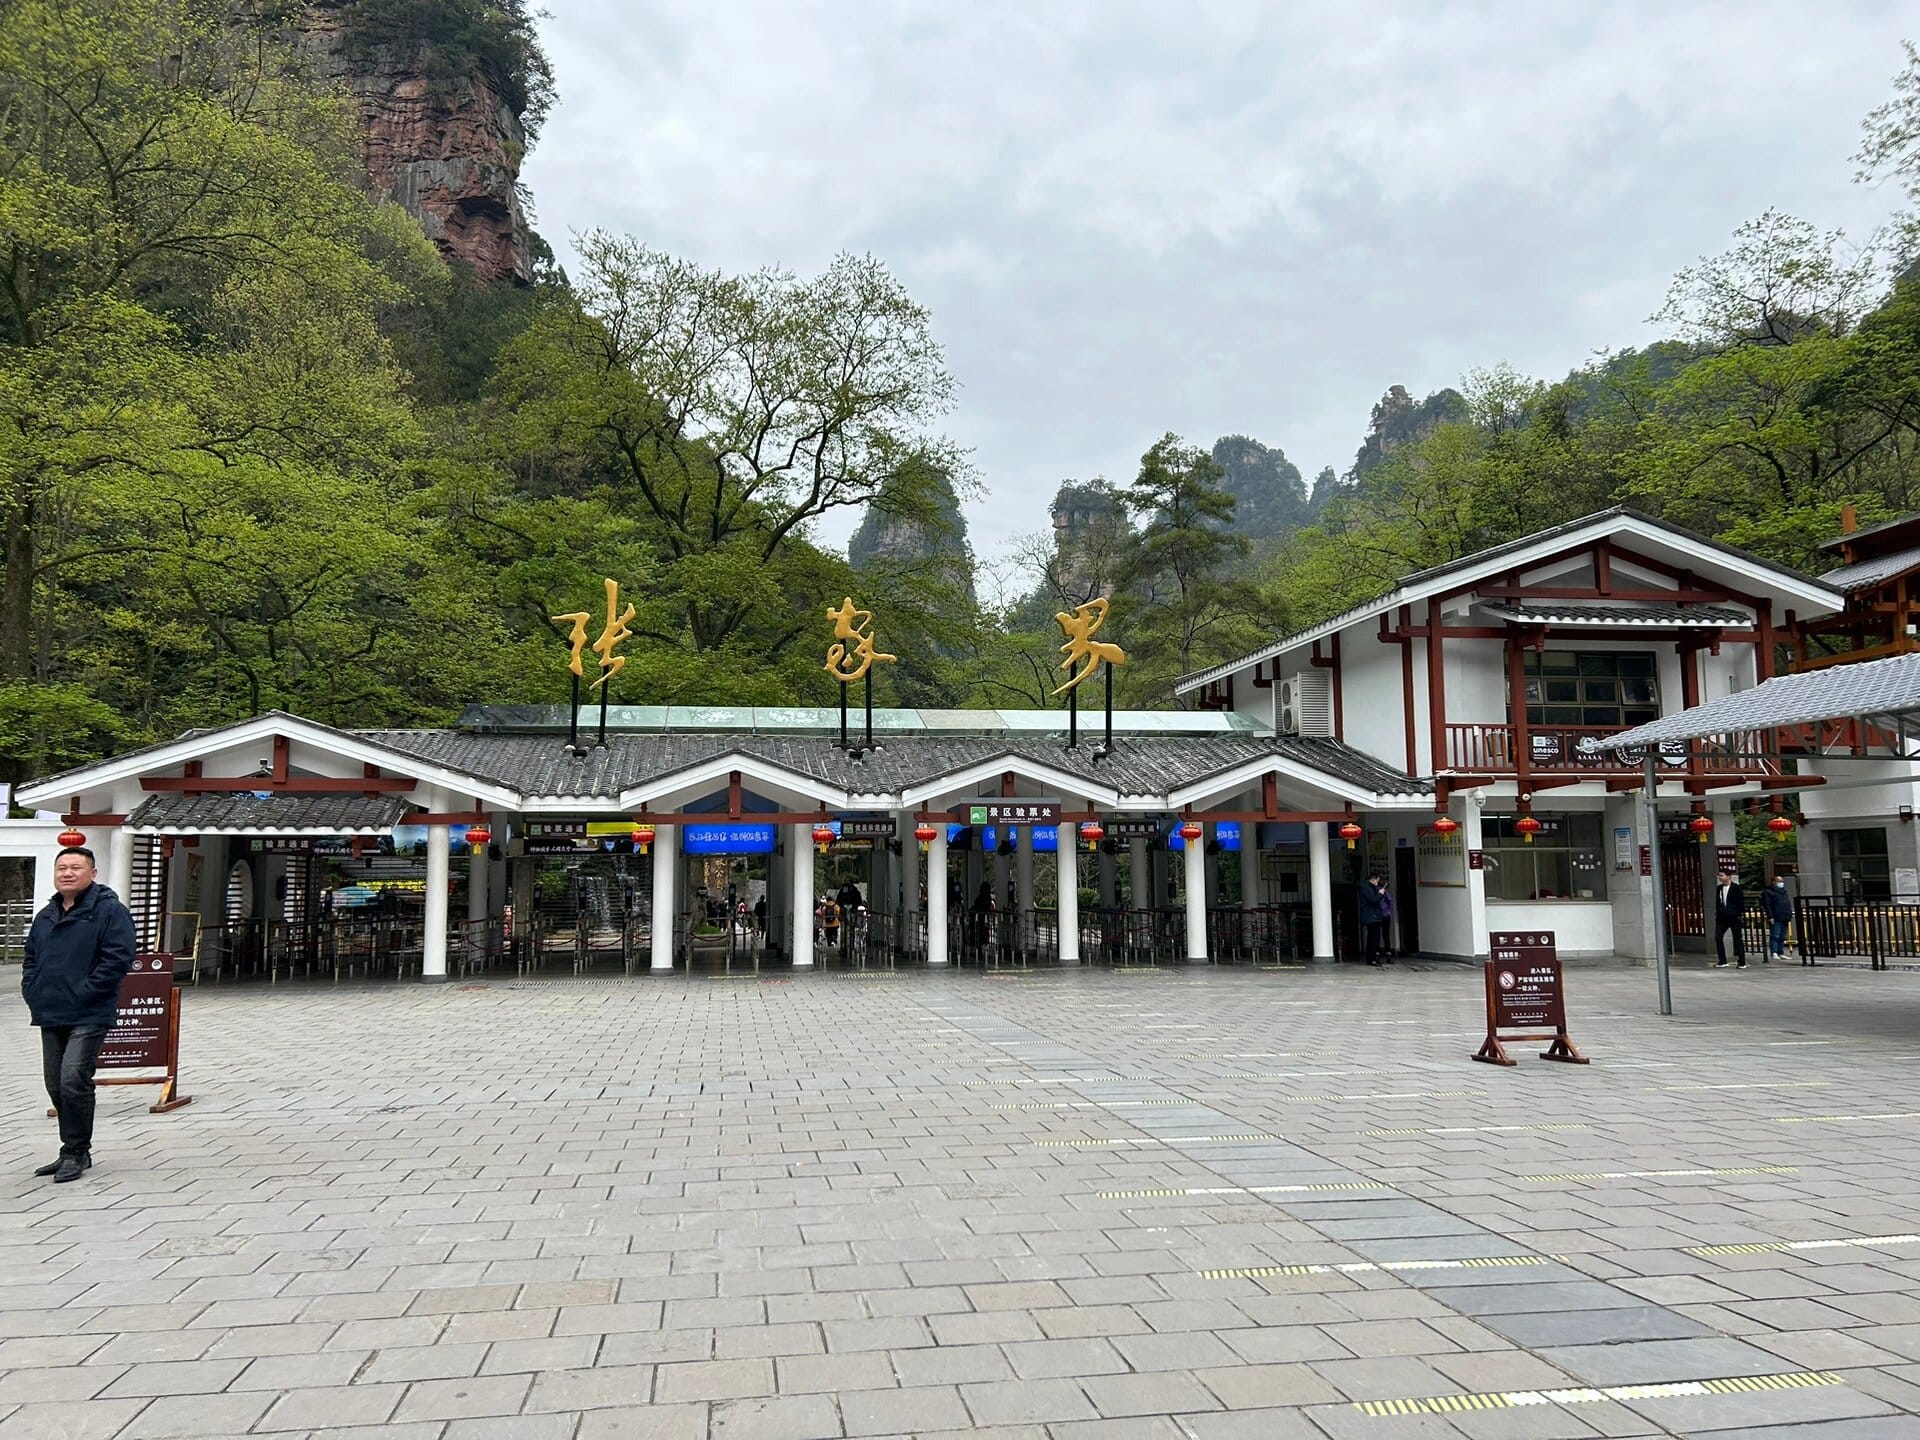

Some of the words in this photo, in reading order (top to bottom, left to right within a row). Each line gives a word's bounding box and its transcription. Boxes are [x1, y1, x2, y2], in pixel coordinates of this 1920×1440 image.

[990, 807, 1052, 817] 景区验票处
[543, 824, 584, 833] 验票通道
[265, 839, 309, 849] 验票通道
[116, 1007, 164, 1016] 禁吸烟及携带
